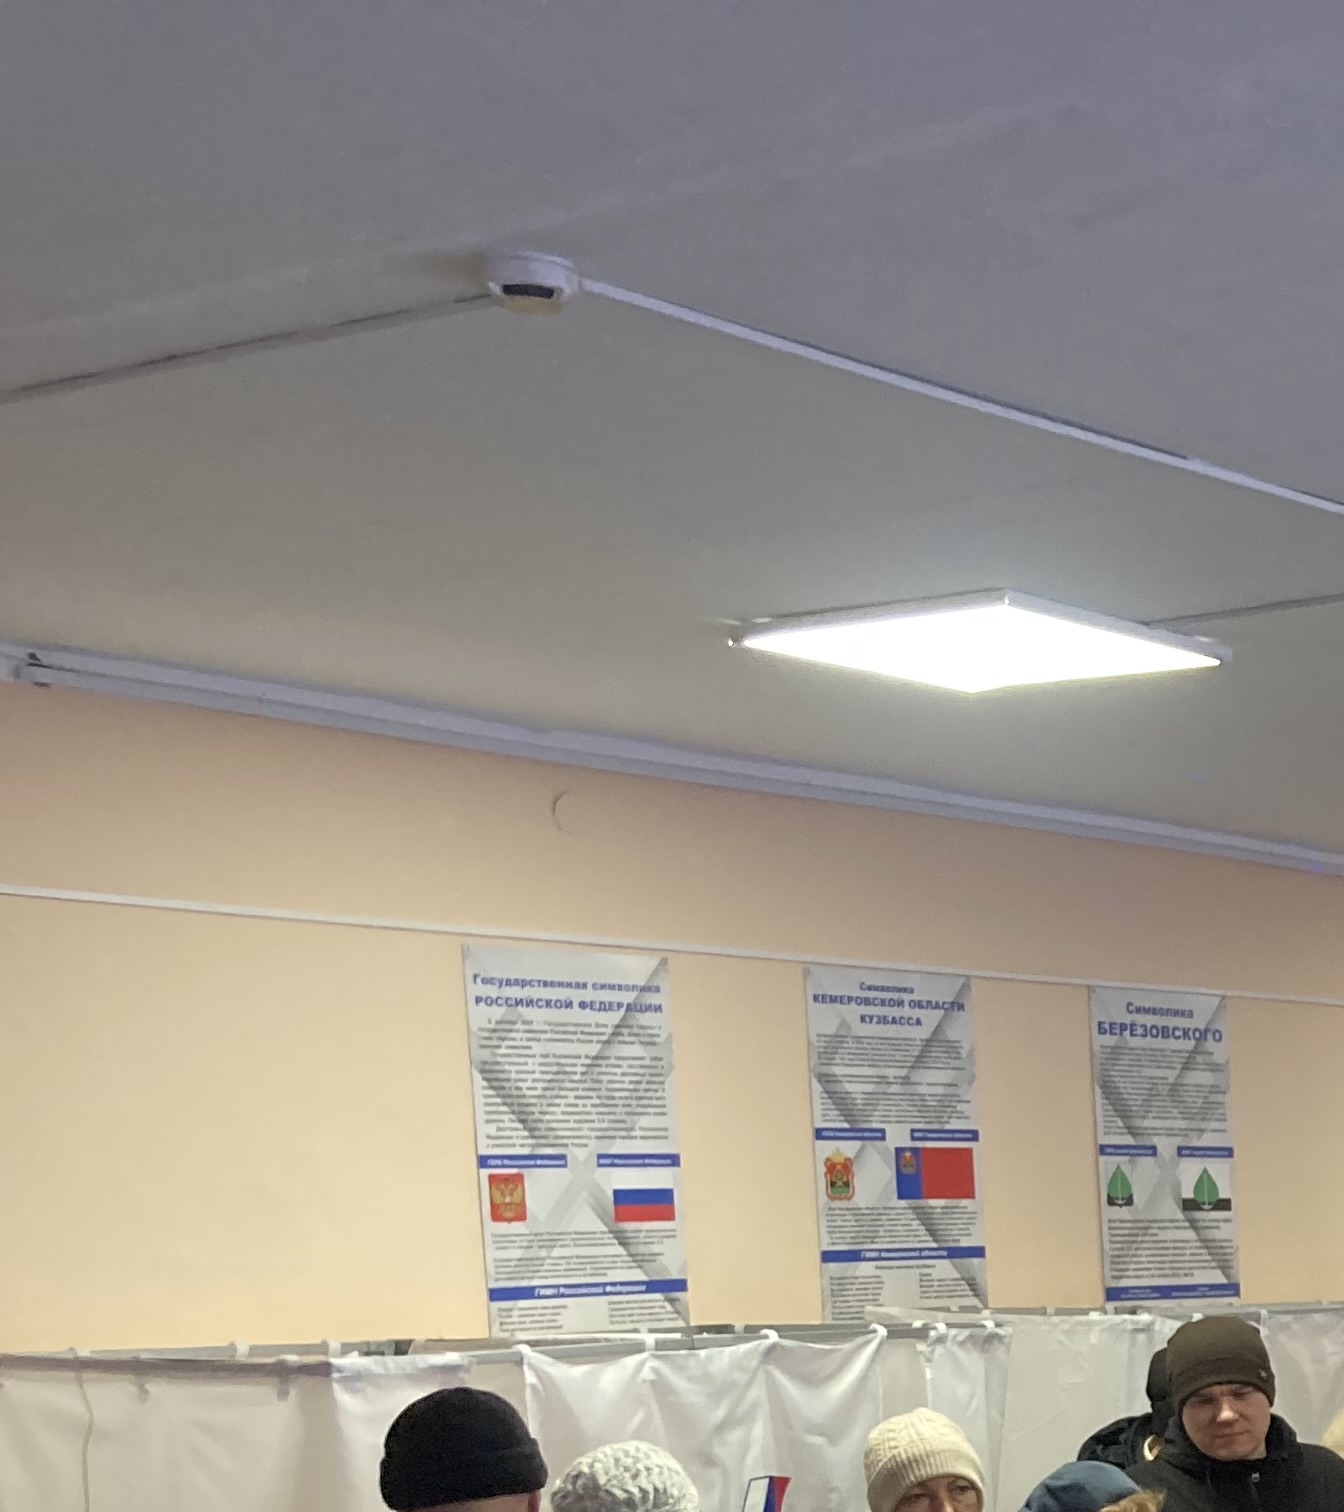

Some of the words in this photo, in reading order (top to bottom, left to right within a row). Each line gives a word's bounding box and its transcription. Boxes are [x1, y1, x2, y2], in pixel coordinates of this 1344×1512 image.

[592, 982, 661, 993] символика
[475, 995, 573, 1010] РОССИЙСКОЙ
[578, 1000, 663, 1014] ФЕДЕРАЦИИ
[813, 993, 905, 1008] КЕМЕРОВСКОЙ
[909, 1000, 965, 1012] ОБЛАСТИ
[1126, 1001, 1194, 1019] Символика
[860, 1014, 922, 1026] КУЗБАССА
[1097, 1020, 1223, 1043] БЕРЁЗОВСКОГО
